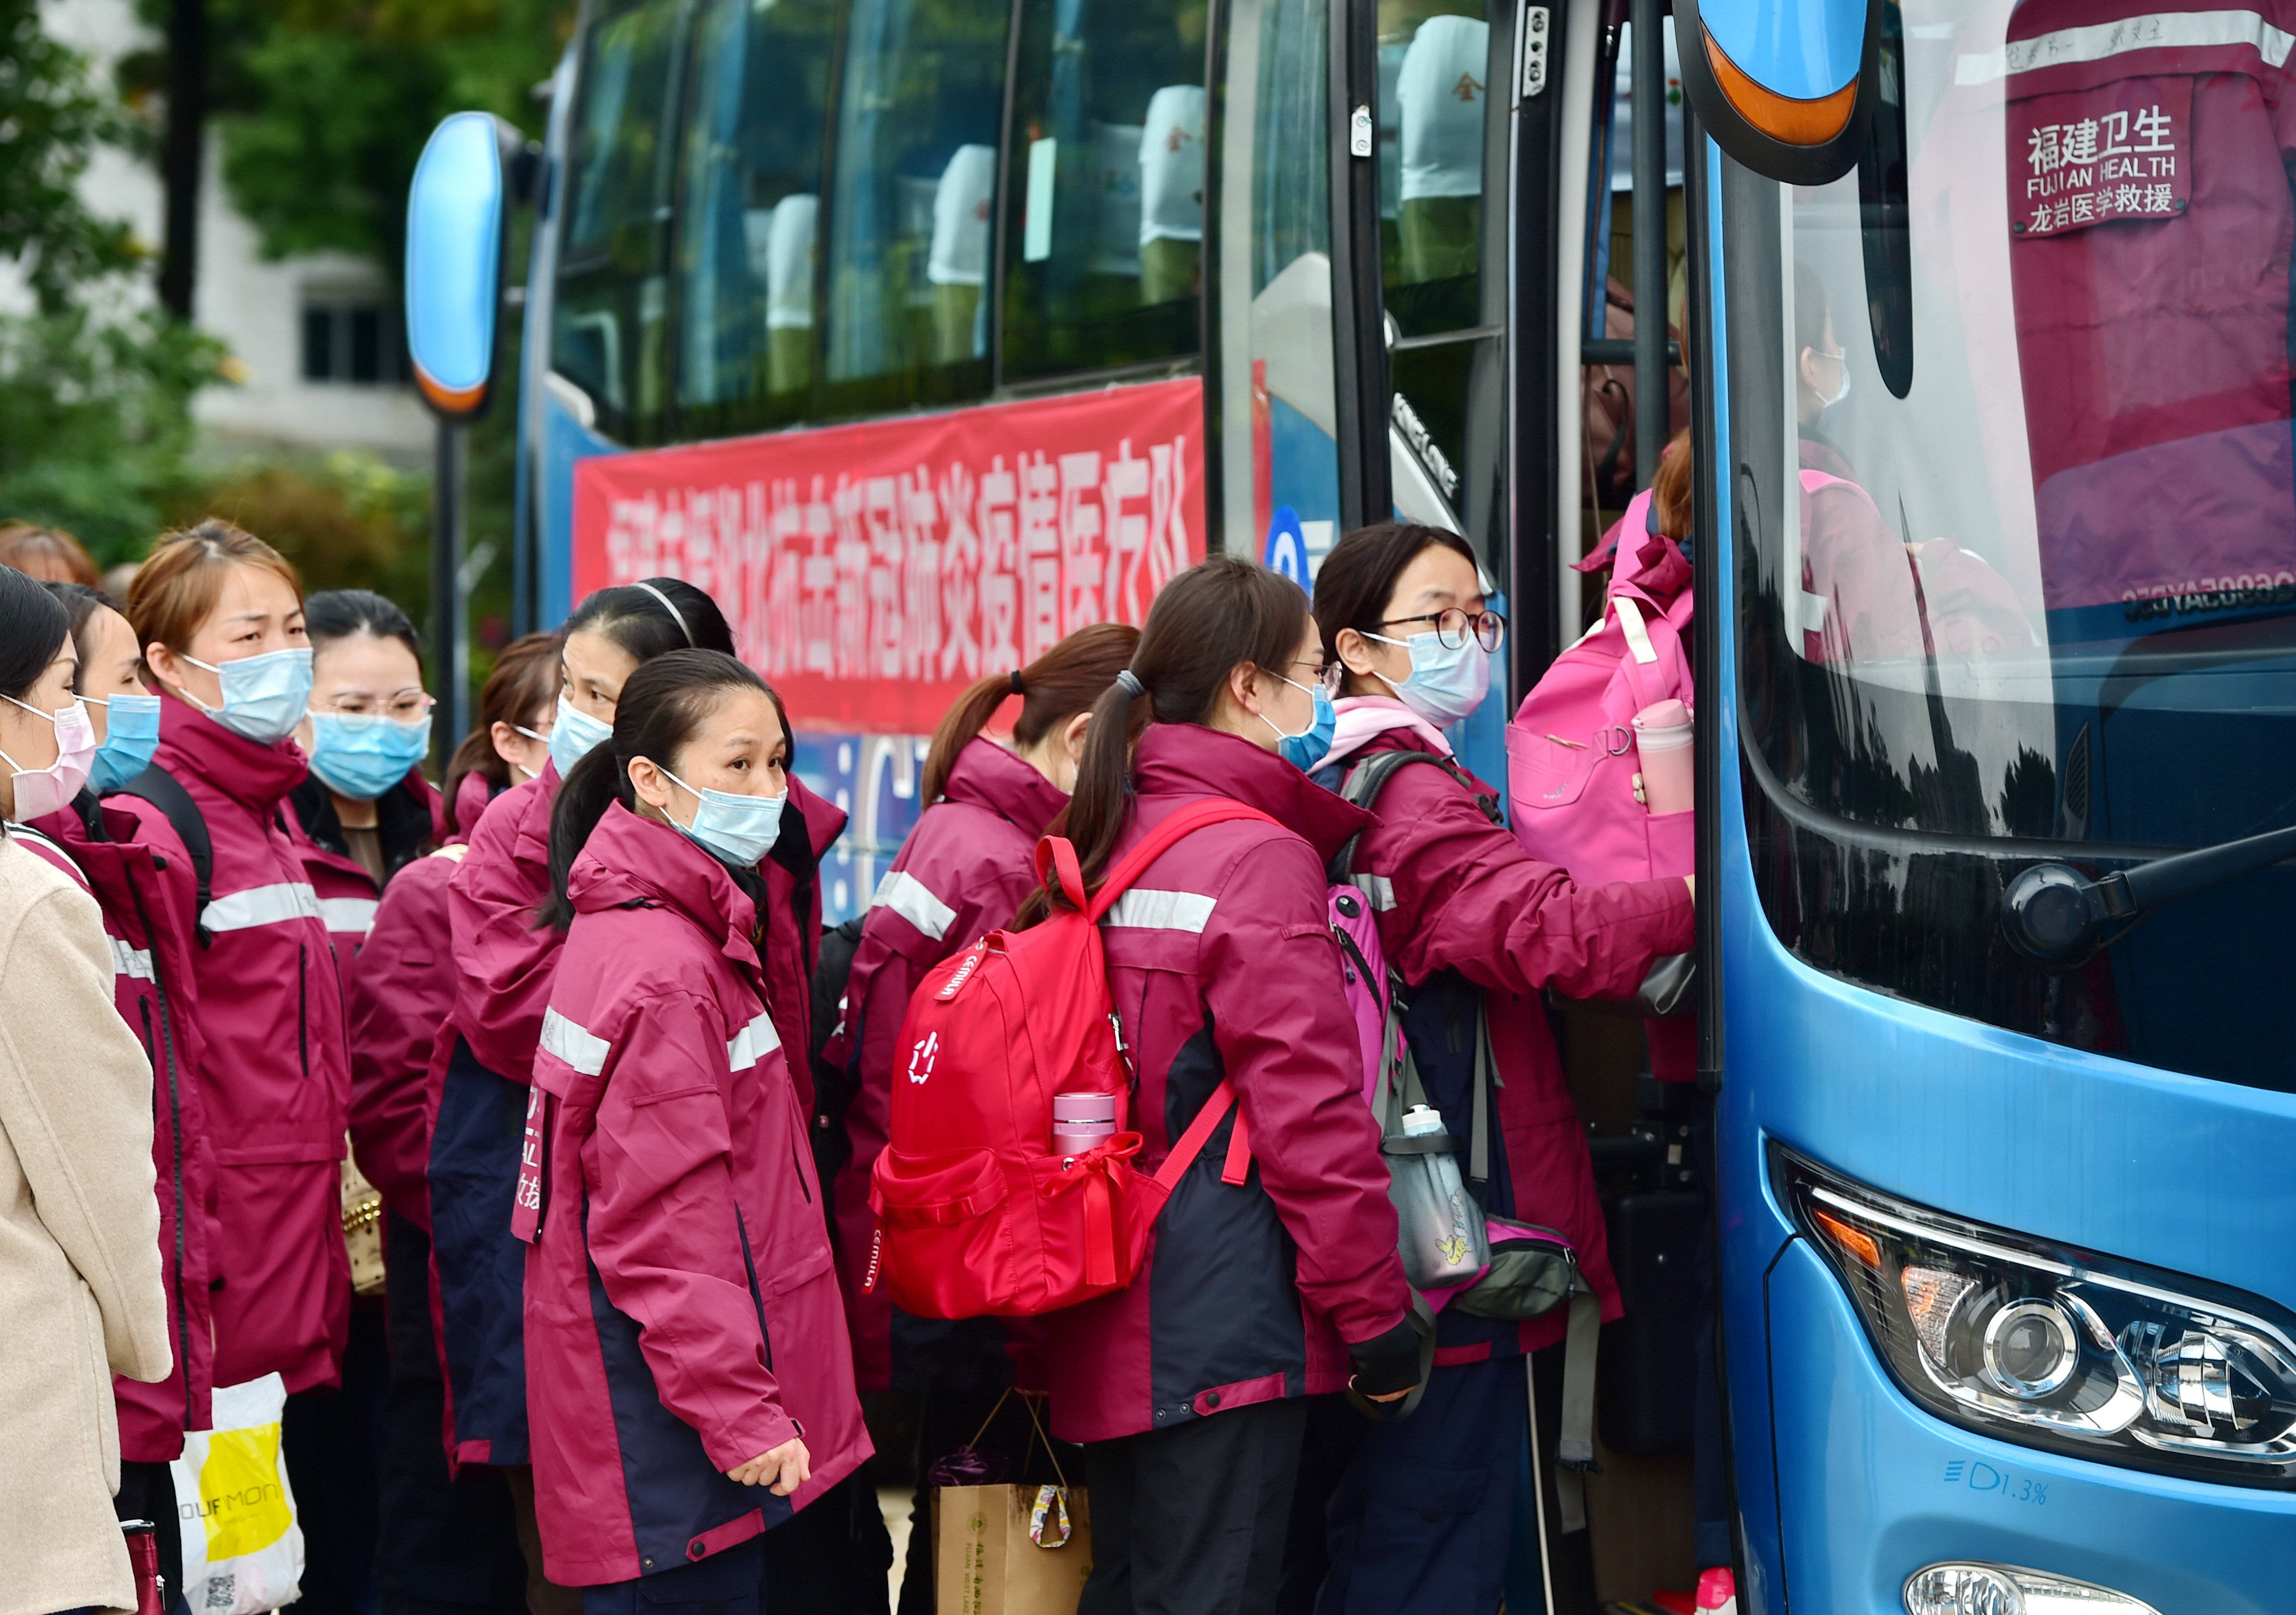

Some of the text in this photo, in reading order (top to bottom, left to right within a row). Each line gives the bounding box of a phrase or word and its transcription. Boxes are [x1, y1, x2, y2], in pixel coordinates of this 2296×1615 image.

[2028, 105, 2175, 175] 福建卫生
[2027, 156, 2175, 199] FUJIAN HEALTH
[2028, 183, 2173, 232] 龙岩医学救援
[2002, 1474, 2049, 1505] 1.3%
